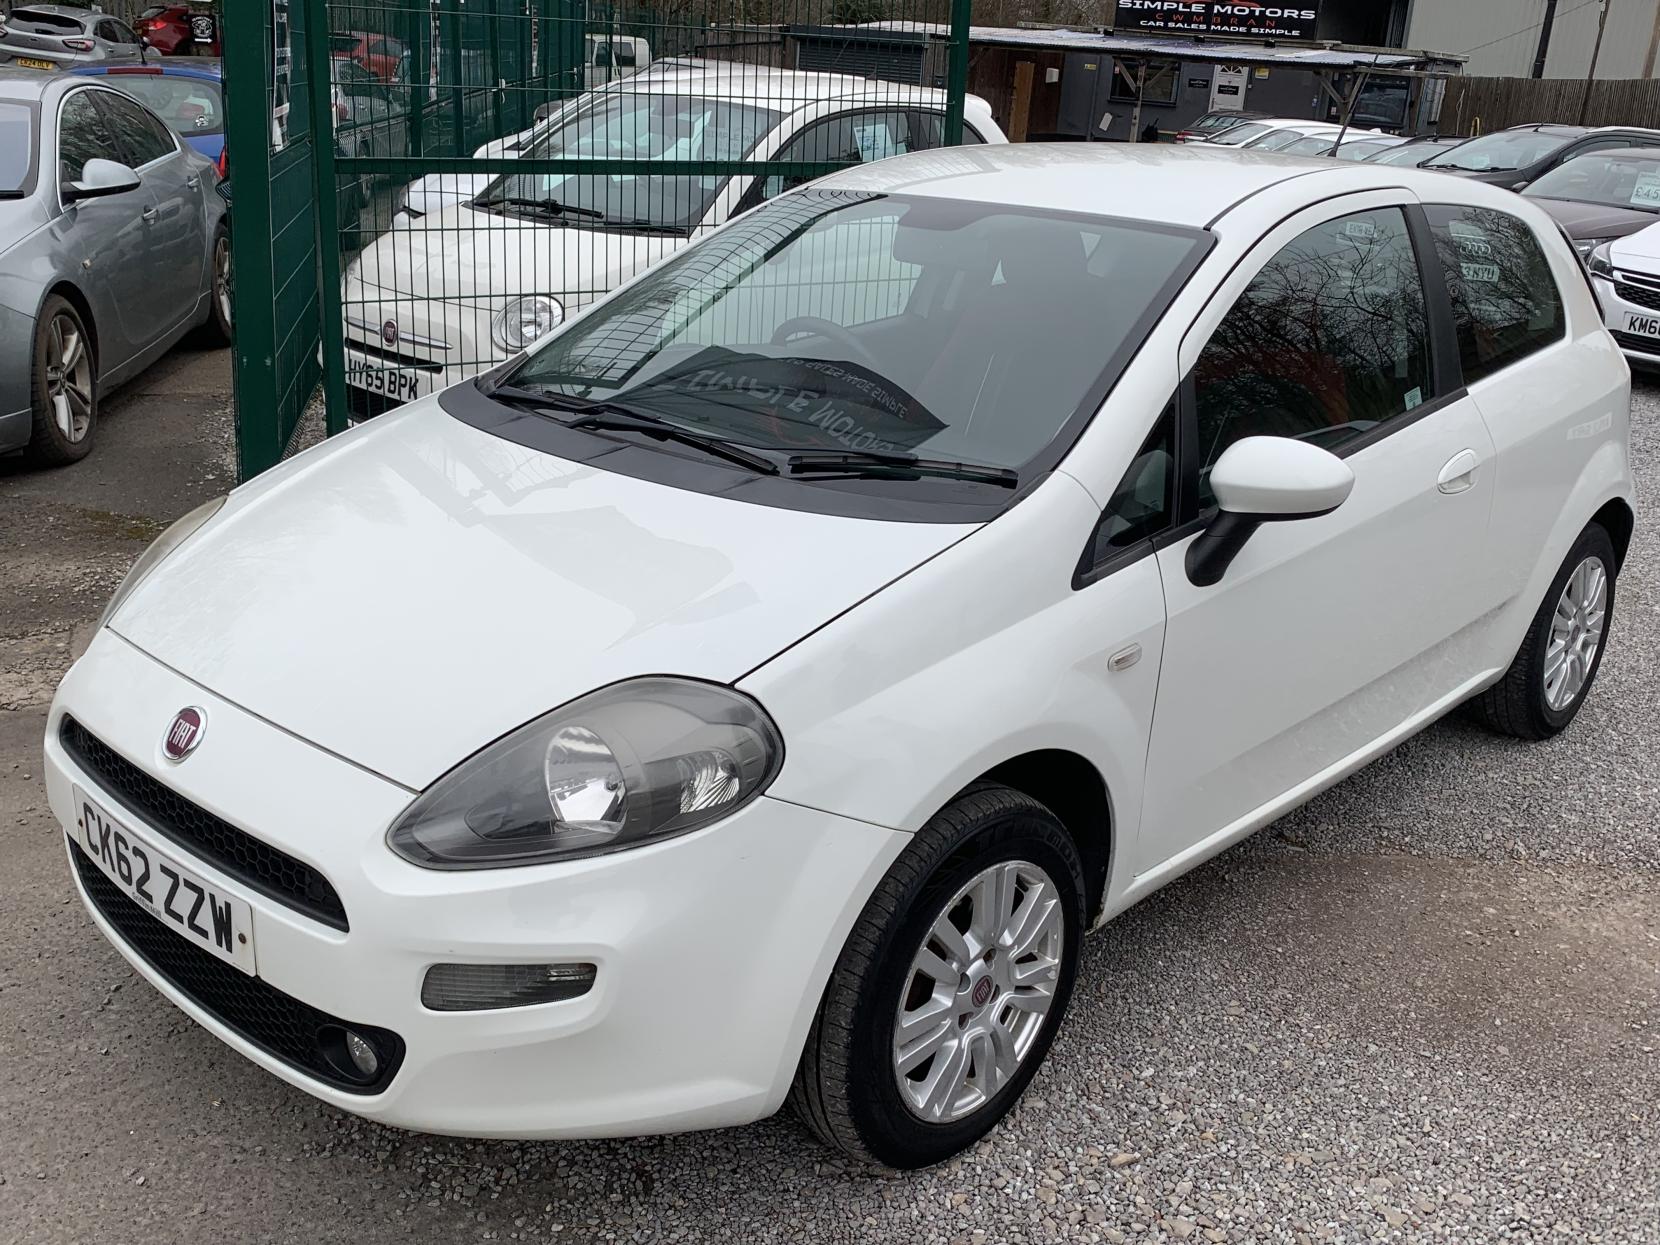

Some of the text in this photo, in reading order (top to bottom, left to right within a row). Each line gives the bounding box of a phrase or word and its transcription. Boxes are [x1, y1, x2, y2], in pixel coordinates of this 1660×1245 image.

[1118, 0, 1316, 19] SIMPLE MOTORS
[1155, 13, 1276, 27] CWMBRAN
[1167, 22, 1207, 30] SALES
[1211, 25, 1248, 33] MADE
[1250, 27, 1301, 36] SIMPLE
[1628, 315, 1660, 336] KM6
[387, 370, 419, 401] BPK
[168, 718, 197, 749] FIAT
[83, 801, 234, 954] CK62 ZZW
